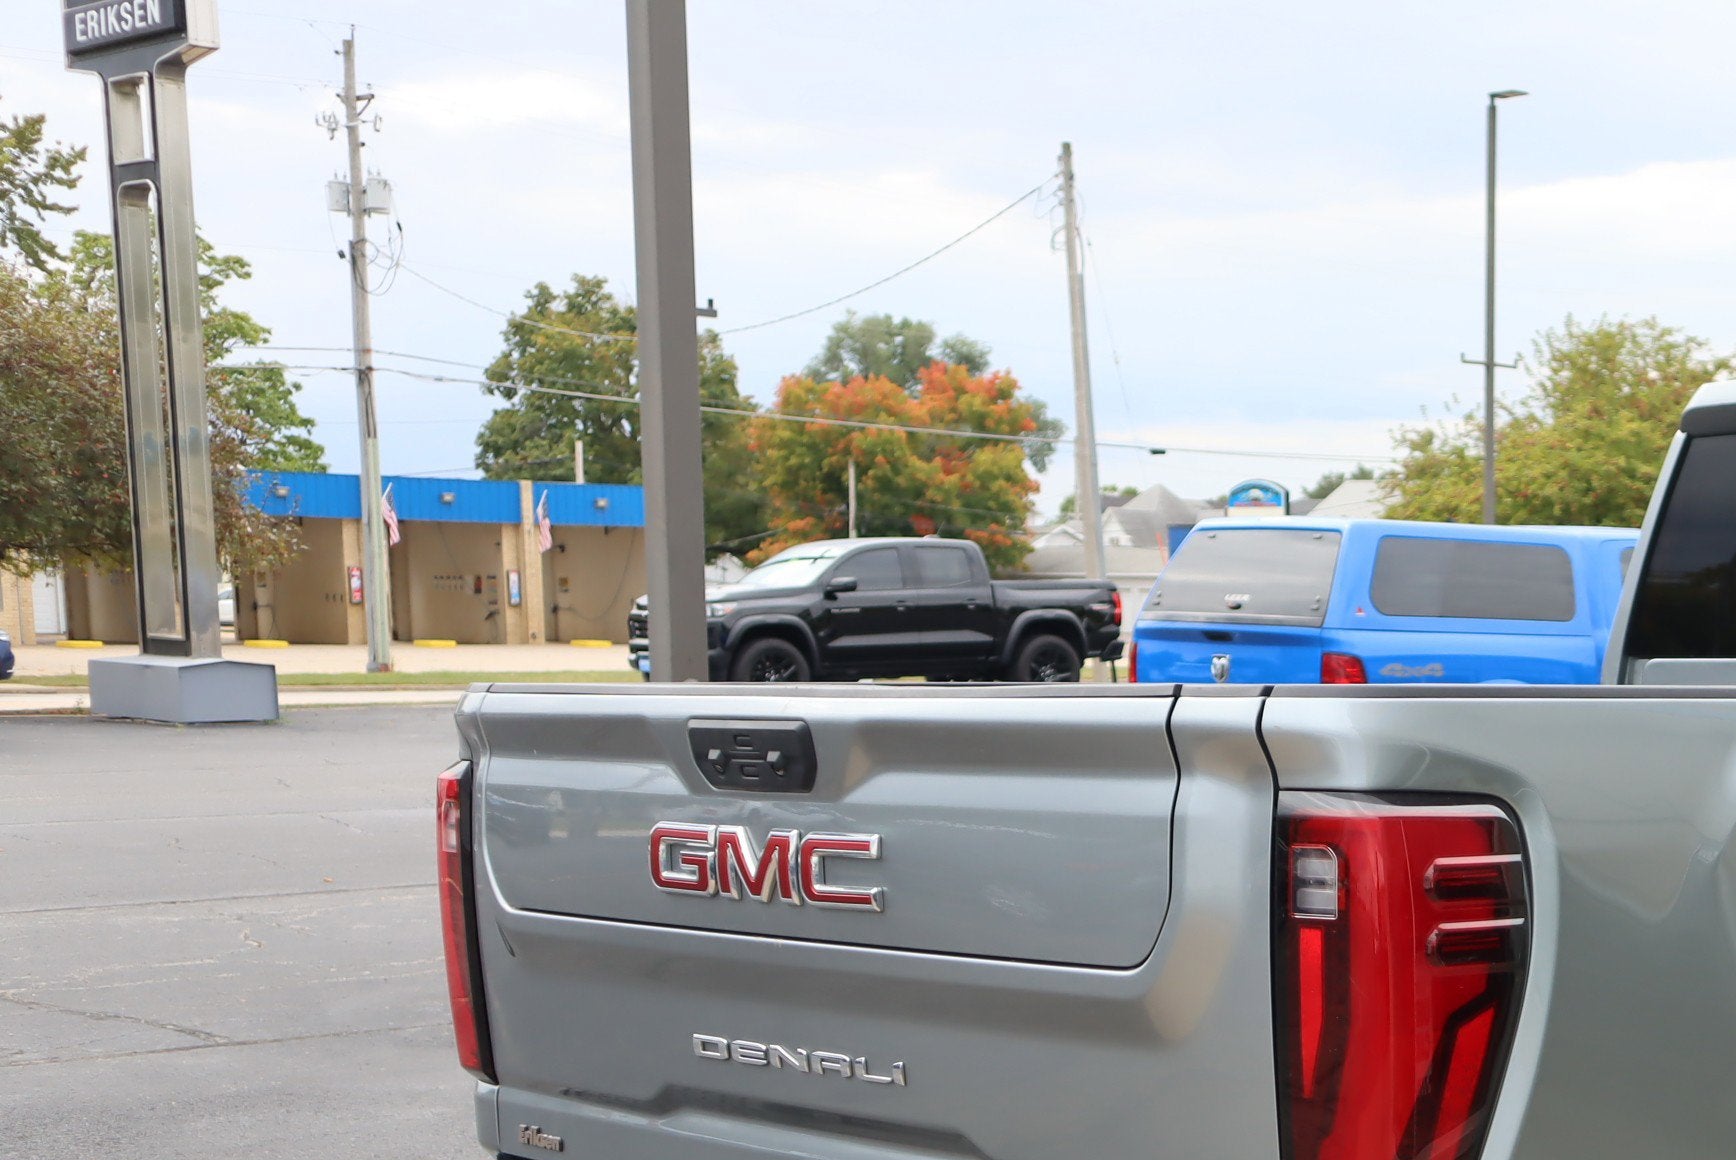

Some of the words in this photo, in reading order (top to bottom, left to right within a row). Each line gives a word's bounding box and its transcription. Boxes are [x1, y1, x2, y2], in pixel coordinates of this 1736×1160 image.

[75, 0, 161, 41] ERIKSEN
[649, 821, 884, 912] GMC
[692, 1033, 908, 1086] DENALI
